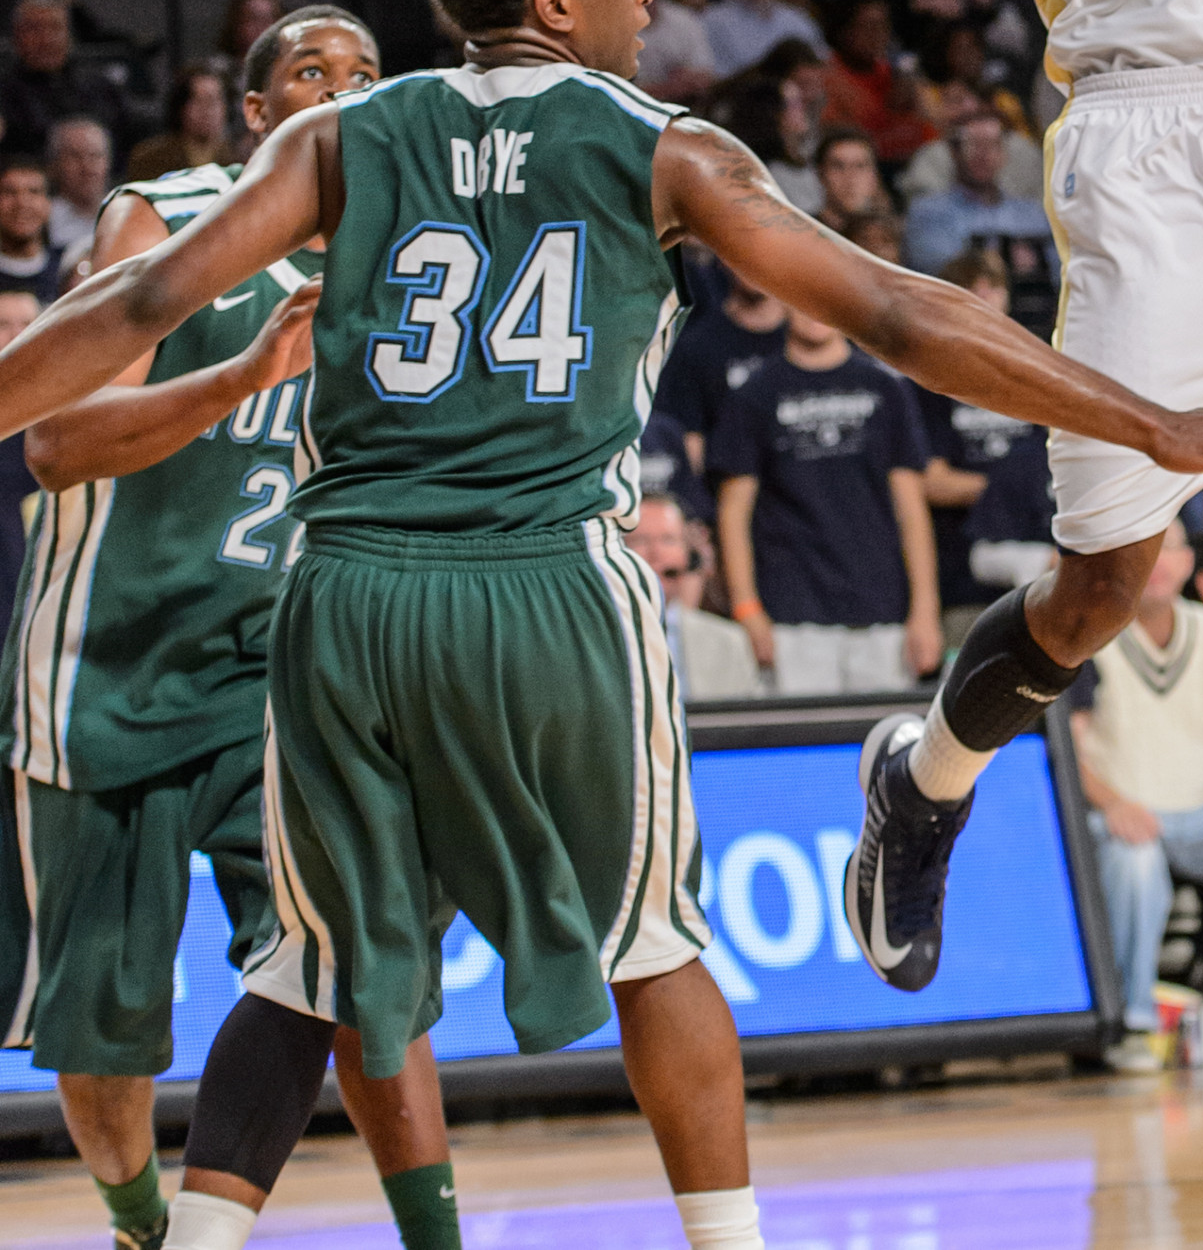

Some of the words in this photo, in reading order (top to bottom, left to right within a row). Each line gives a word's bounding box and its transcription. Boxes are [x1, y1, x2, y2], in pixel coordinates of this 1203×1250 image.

[364, 220, 593, 403] 34
[202, 378, 303, 446] UL
[216, 463, 306, 572] 2
